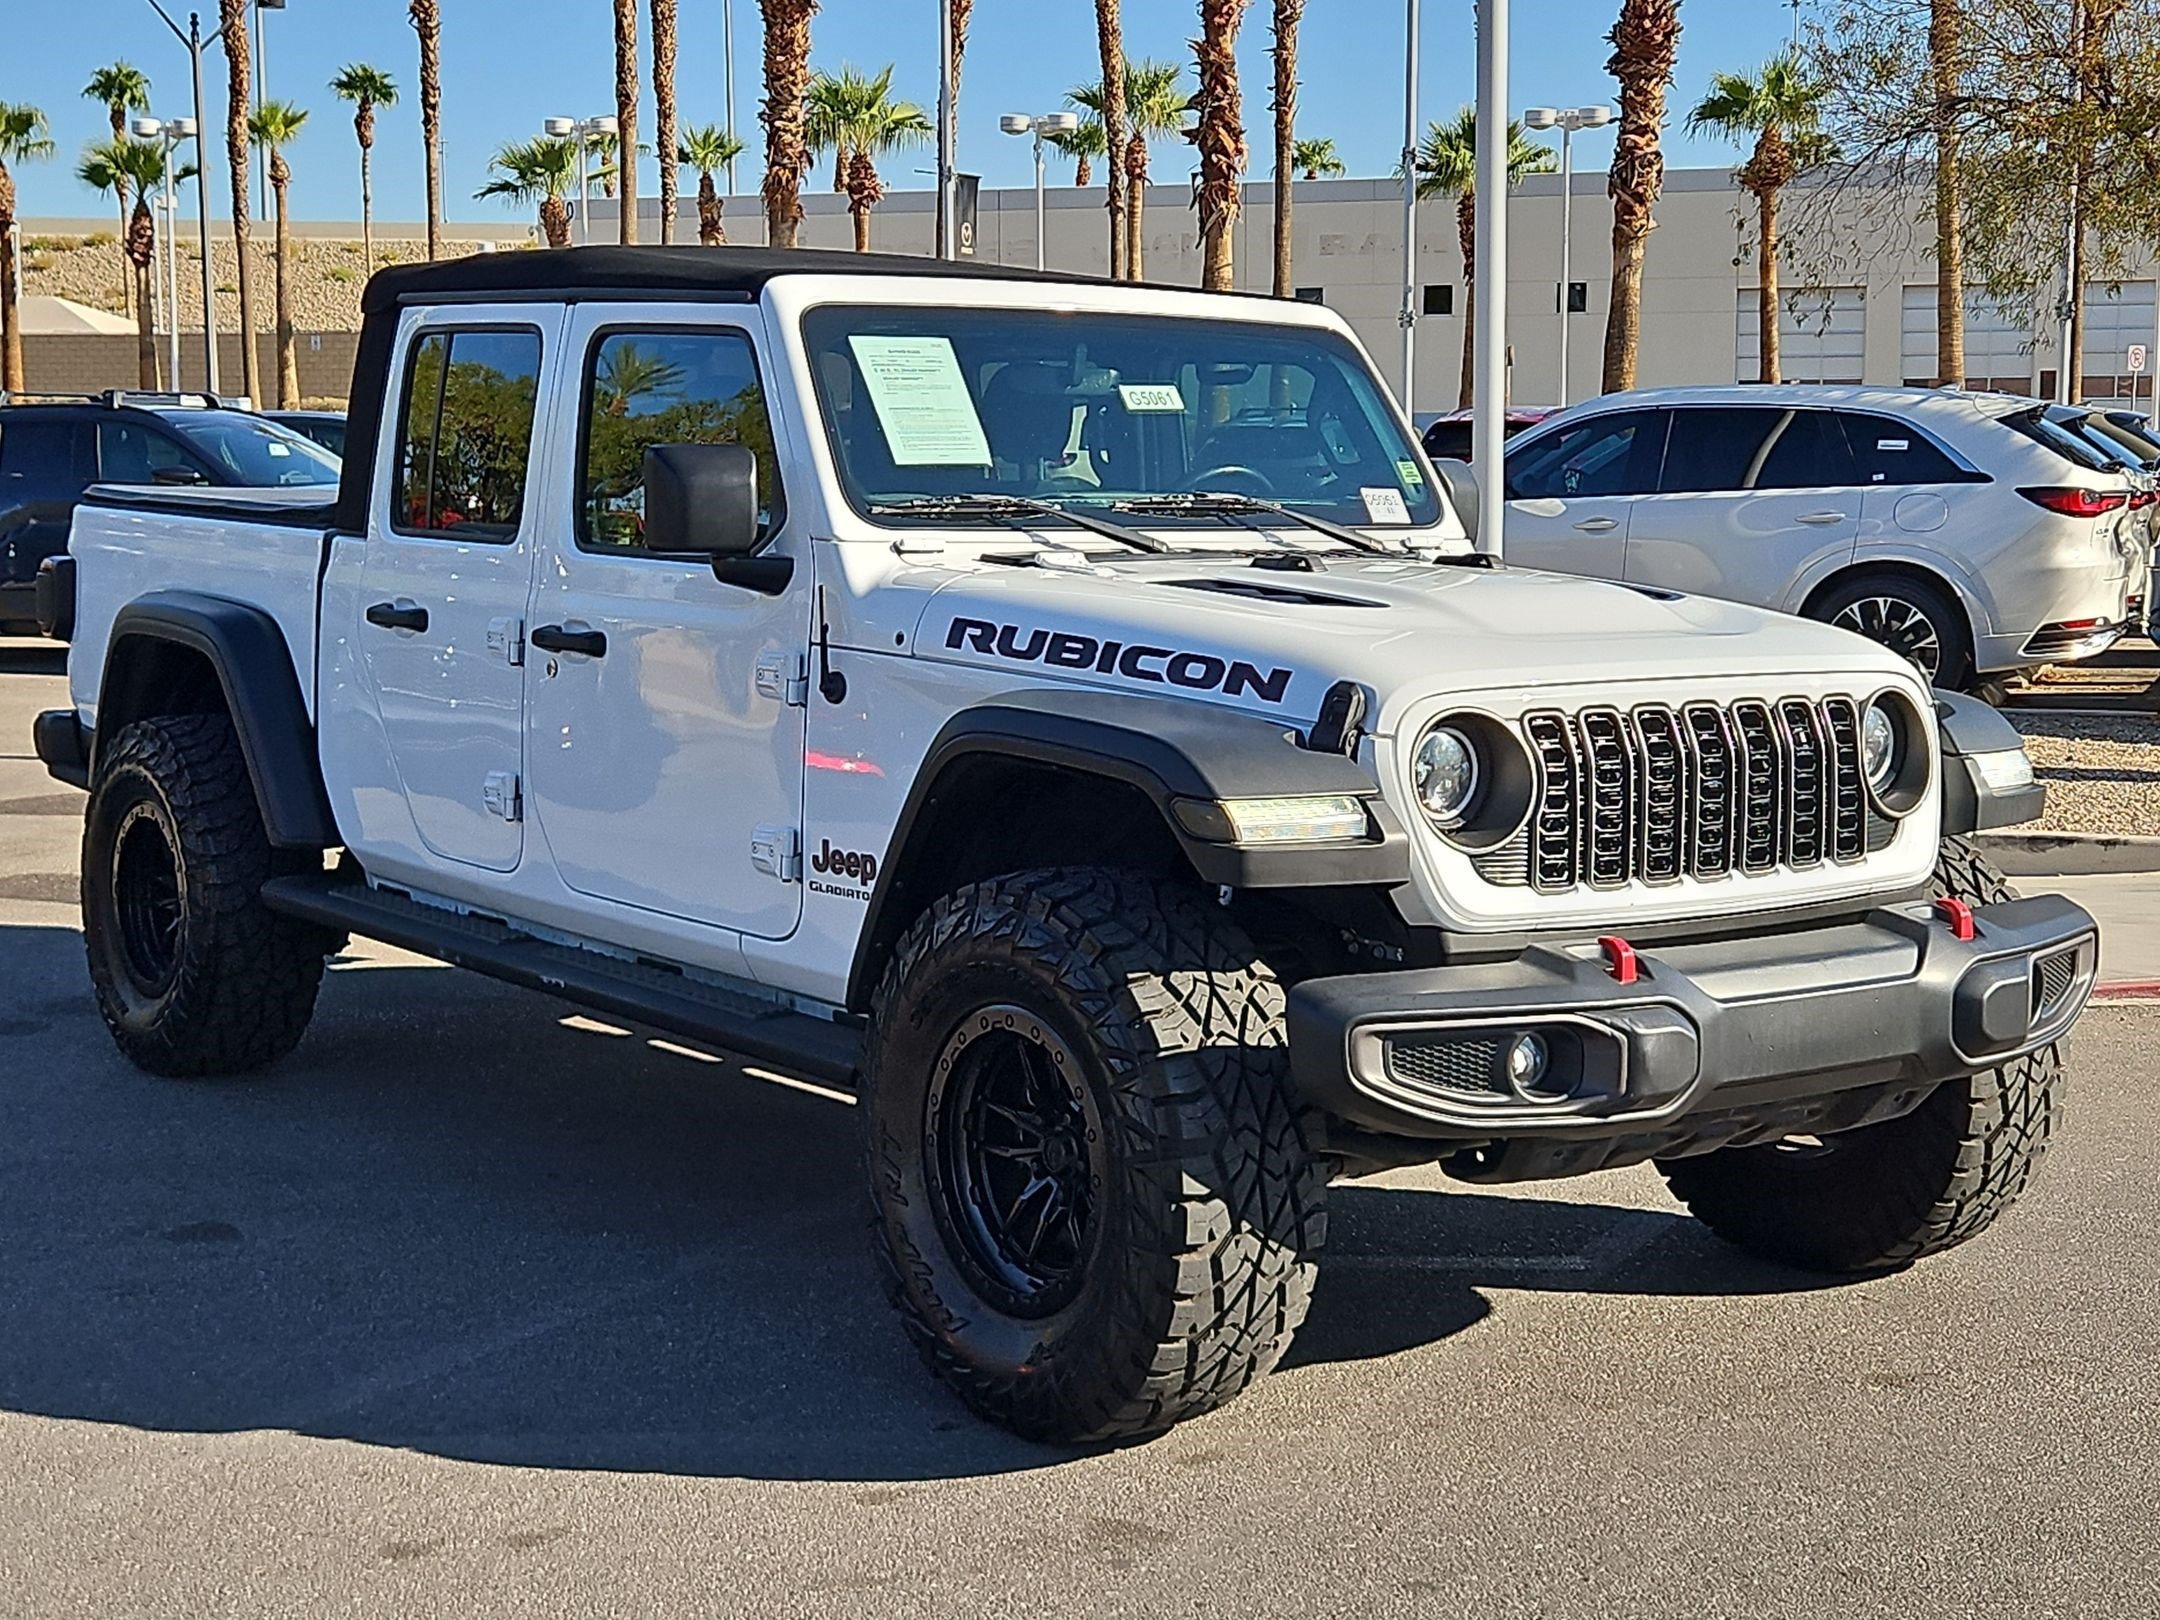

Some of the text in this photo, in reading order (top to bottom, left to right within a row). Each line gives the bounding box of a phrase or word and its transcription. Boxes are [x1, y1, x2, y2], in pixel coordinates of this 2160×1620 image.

[1129, 391, 1175, 406] G5061
[945, 617, 1293, 703] RUBICON
[811, 838, 877, 887] Jeep
[809, 880, 870, 901] GLADIATO
